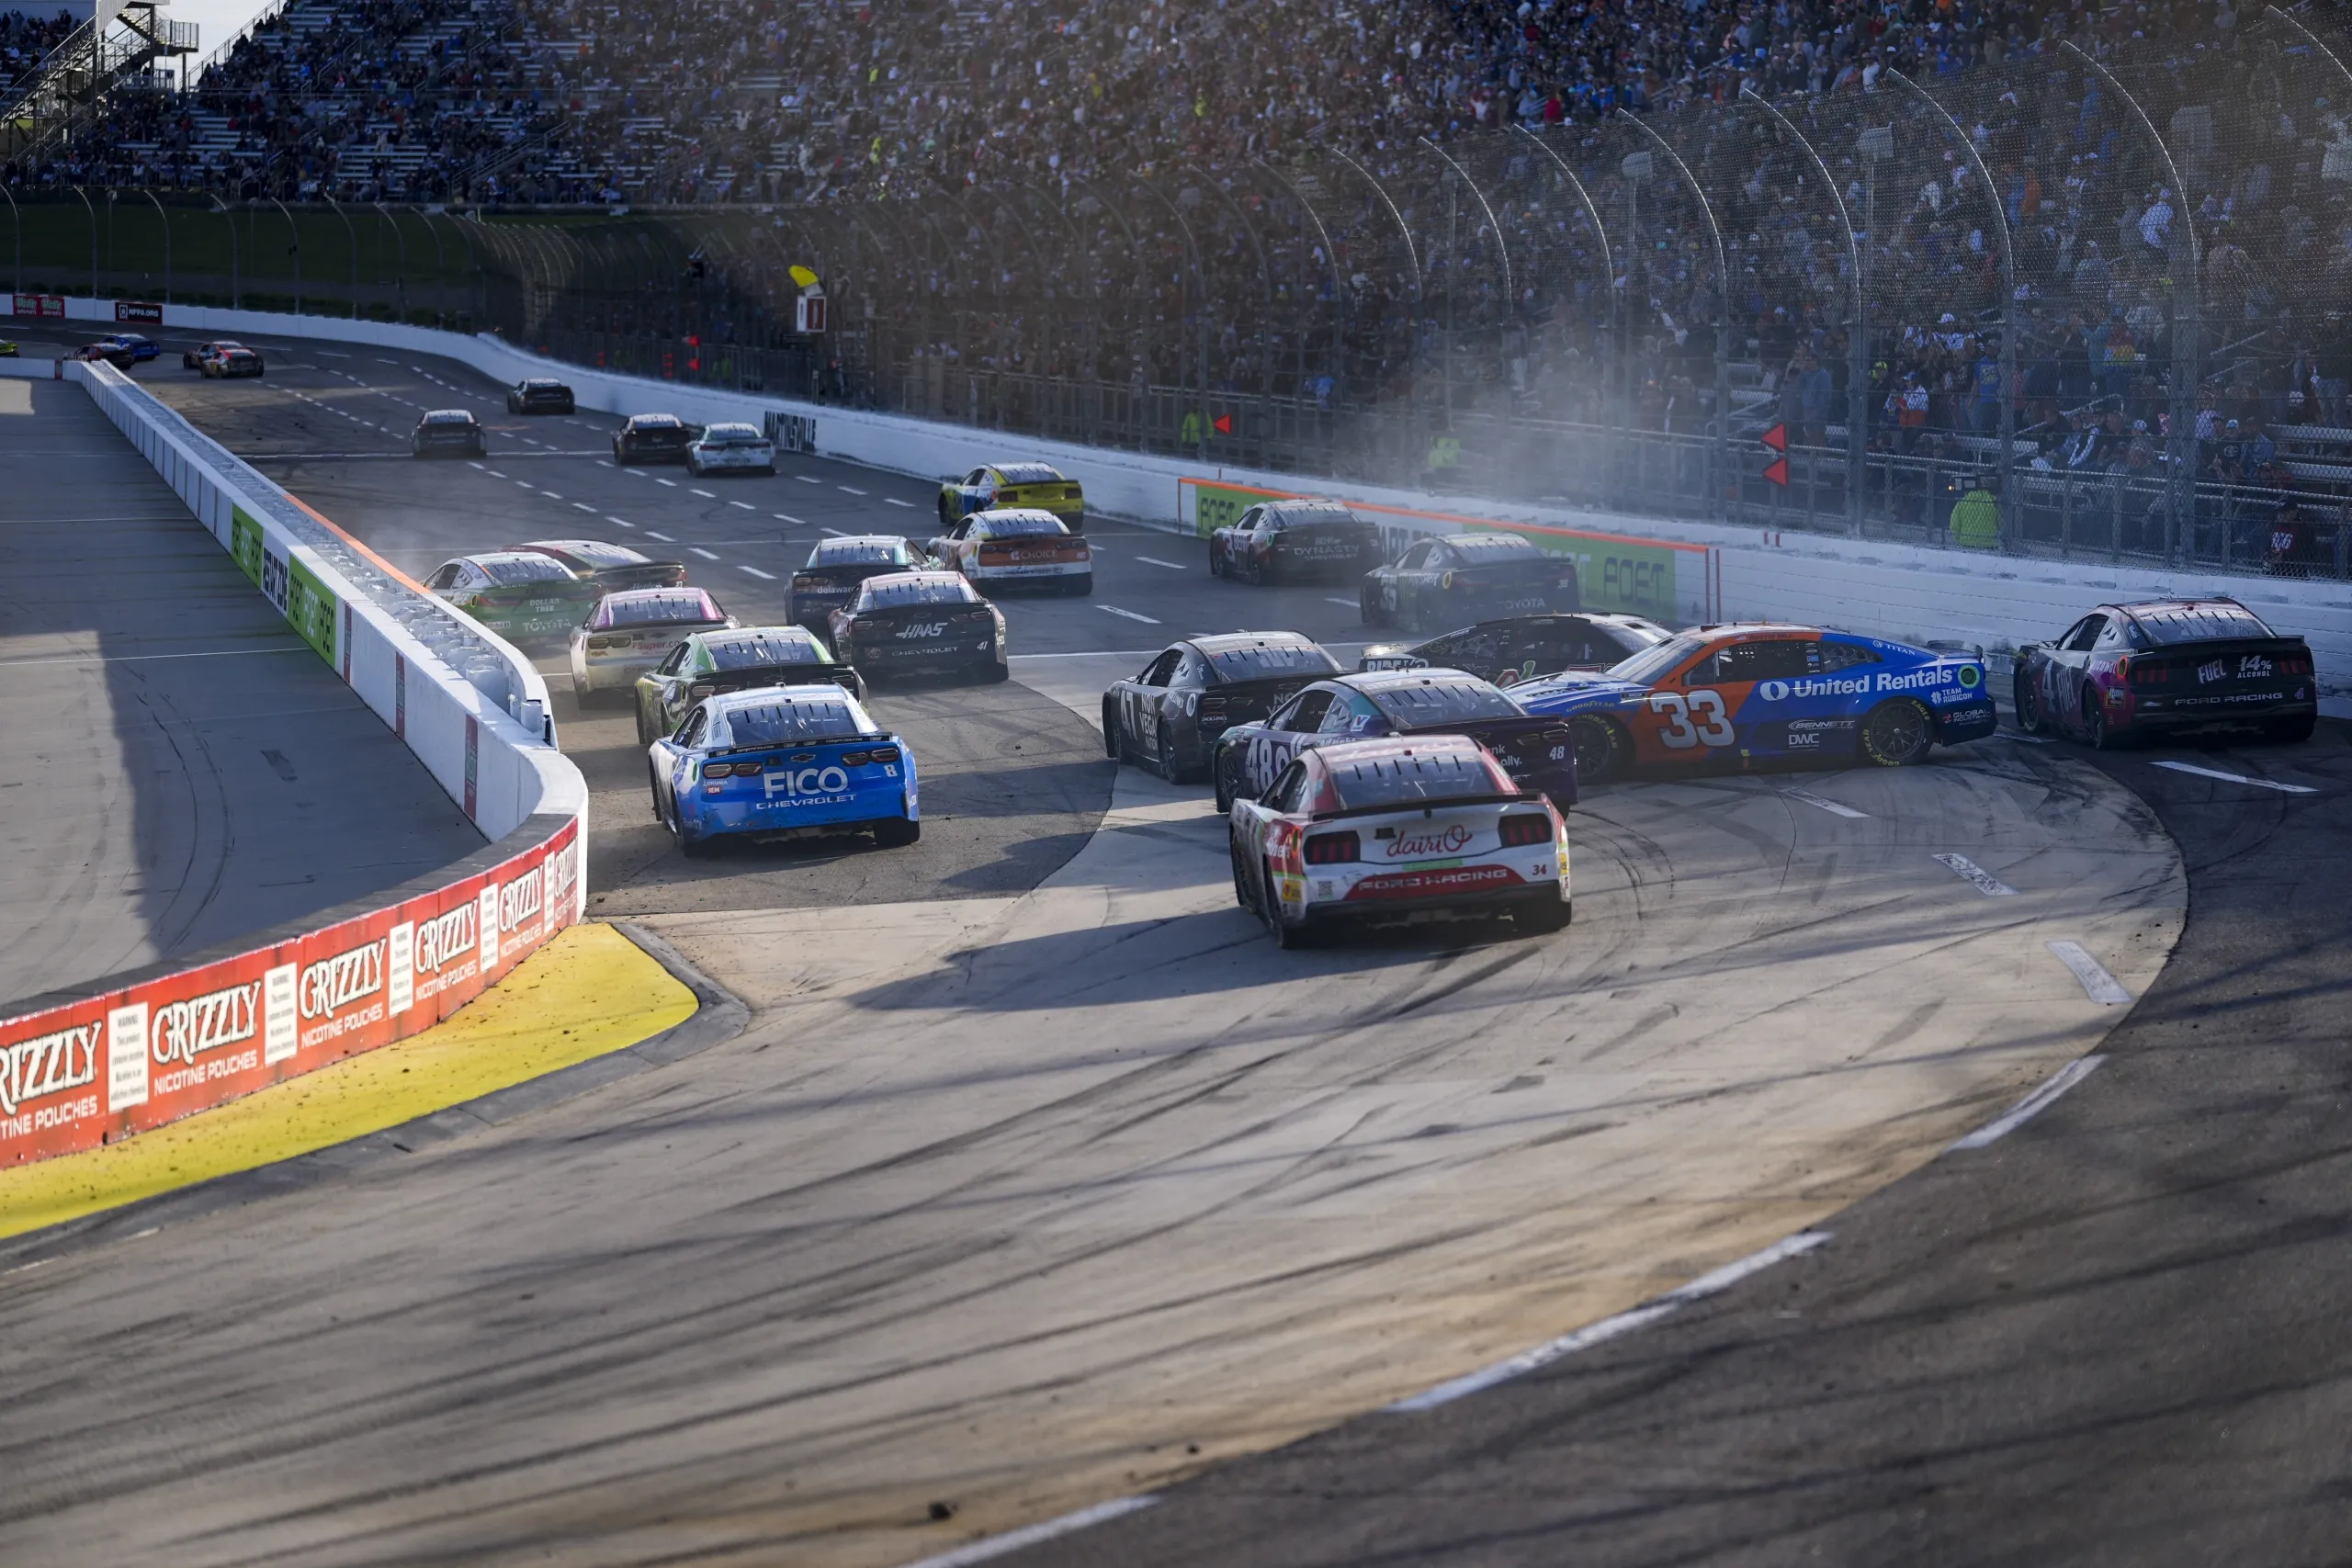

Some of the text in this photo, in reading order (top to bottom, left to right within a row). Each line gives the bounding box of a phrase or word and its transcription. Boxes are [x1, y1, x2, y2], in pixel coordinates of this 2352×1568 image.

[128, 308, 159, 318] NFPA.ORG
[1020, 549, 1057, 560] CHOICE
[1294, 545, 1360, 556] DYNASTY
[1604, 557, 1665, 608] POET
[529, 597, 560, 606] DOLLAR
[1497, 597, 1546, 609] TOYOTA
[895, 622, 948, 639] HAAS
[892, 646, 959, 657] CHEVROLET
[977, 640, 988, 650] 41
[1886, 643, 1916, 656] TITAN
[2197, 658, 2227, 684] FUEL
[2238, 655, 2272, 671] 14%
[1793, 666, 1953, 697] United Rentals
[2236, 670, 2270, 679] ALCOHOL
[1942, 687, 1962, 696] TEAM
[2041, 659, 2056, 713] 4
[2294, 687, 2305, 699] 4
[1566, 699, 1615, 713] GOODYEAR
[1942, 693, 1973, 704] RUBICON
[2175, 692, 2283, 705] FORD RACING
[1120, 689, 1138, 740] 47
[1648, 687, 1736, 750] 33
[1952, 708, 1990, 718] GLOBAL
[1789, 733, 1820, 745] DWC
[1549, 745, 1566, 761] 48
[883, 764, 898, 777] 8
[1245, 737, 1273, 795] 48
[707, 786, 720, 795] SEM
[763, 766, 848, 799] FICO
[755, 794, 857, 810] CHEVROLET
[1532, 864, 1547, 876] 34
[1358, 868, 1508, 891] FORD RACING
[498, 862, 544, 934] GRIZZLY
[414, 896, 479, 976] GRIZZLY
[299, 936, 387, 1021] GRIZZLY
[152, 979, 262, 1066] GRIZZLY
[300, 1001, 383, 1050] NICOTINE POUCHES
[154, 1049, 258, 1097] NICOTINE POUCHES
[0, 1094, 98, 1140] TINE POUCHES
